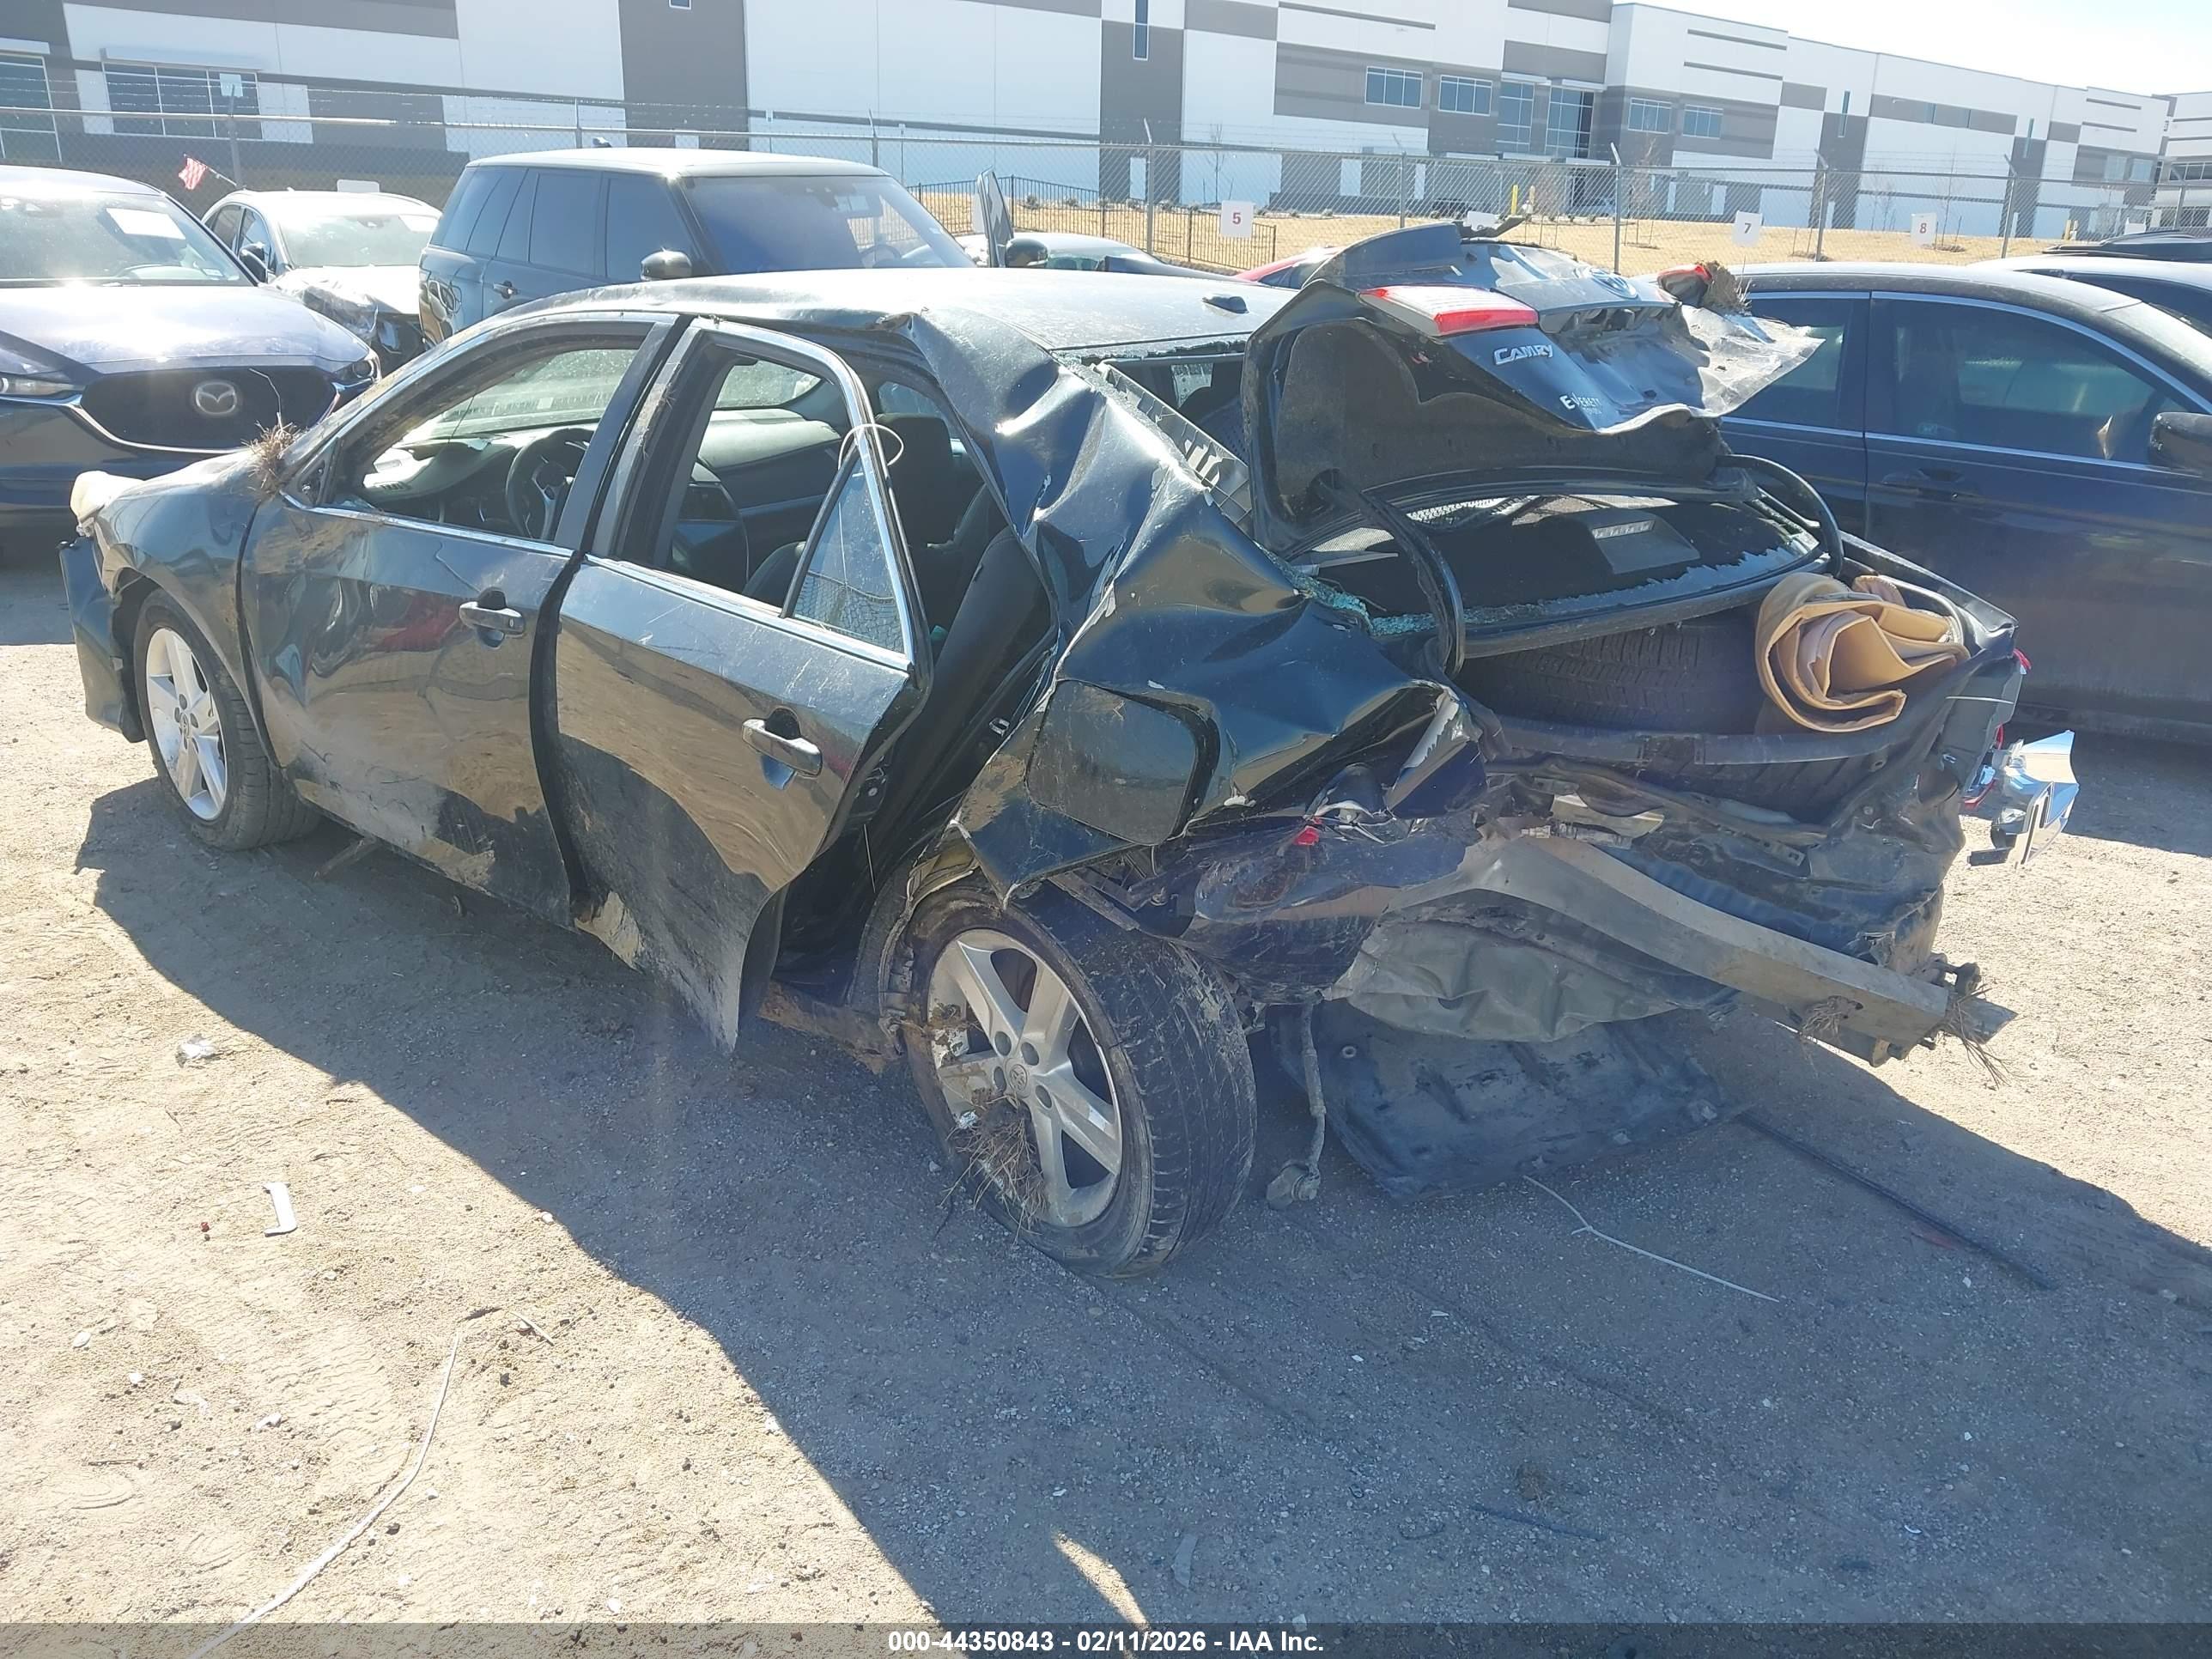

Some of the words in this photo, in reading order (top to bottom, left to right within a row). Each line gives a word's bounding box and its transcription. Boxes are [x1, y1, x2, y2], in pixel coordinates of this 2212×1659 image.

[1232, 212, 1242, 225] 5
[1744, 222, 1752, 234] 7
[1919, 222, 1927, 234] 8
[1493, 344, 1553, 365] CAMRY
